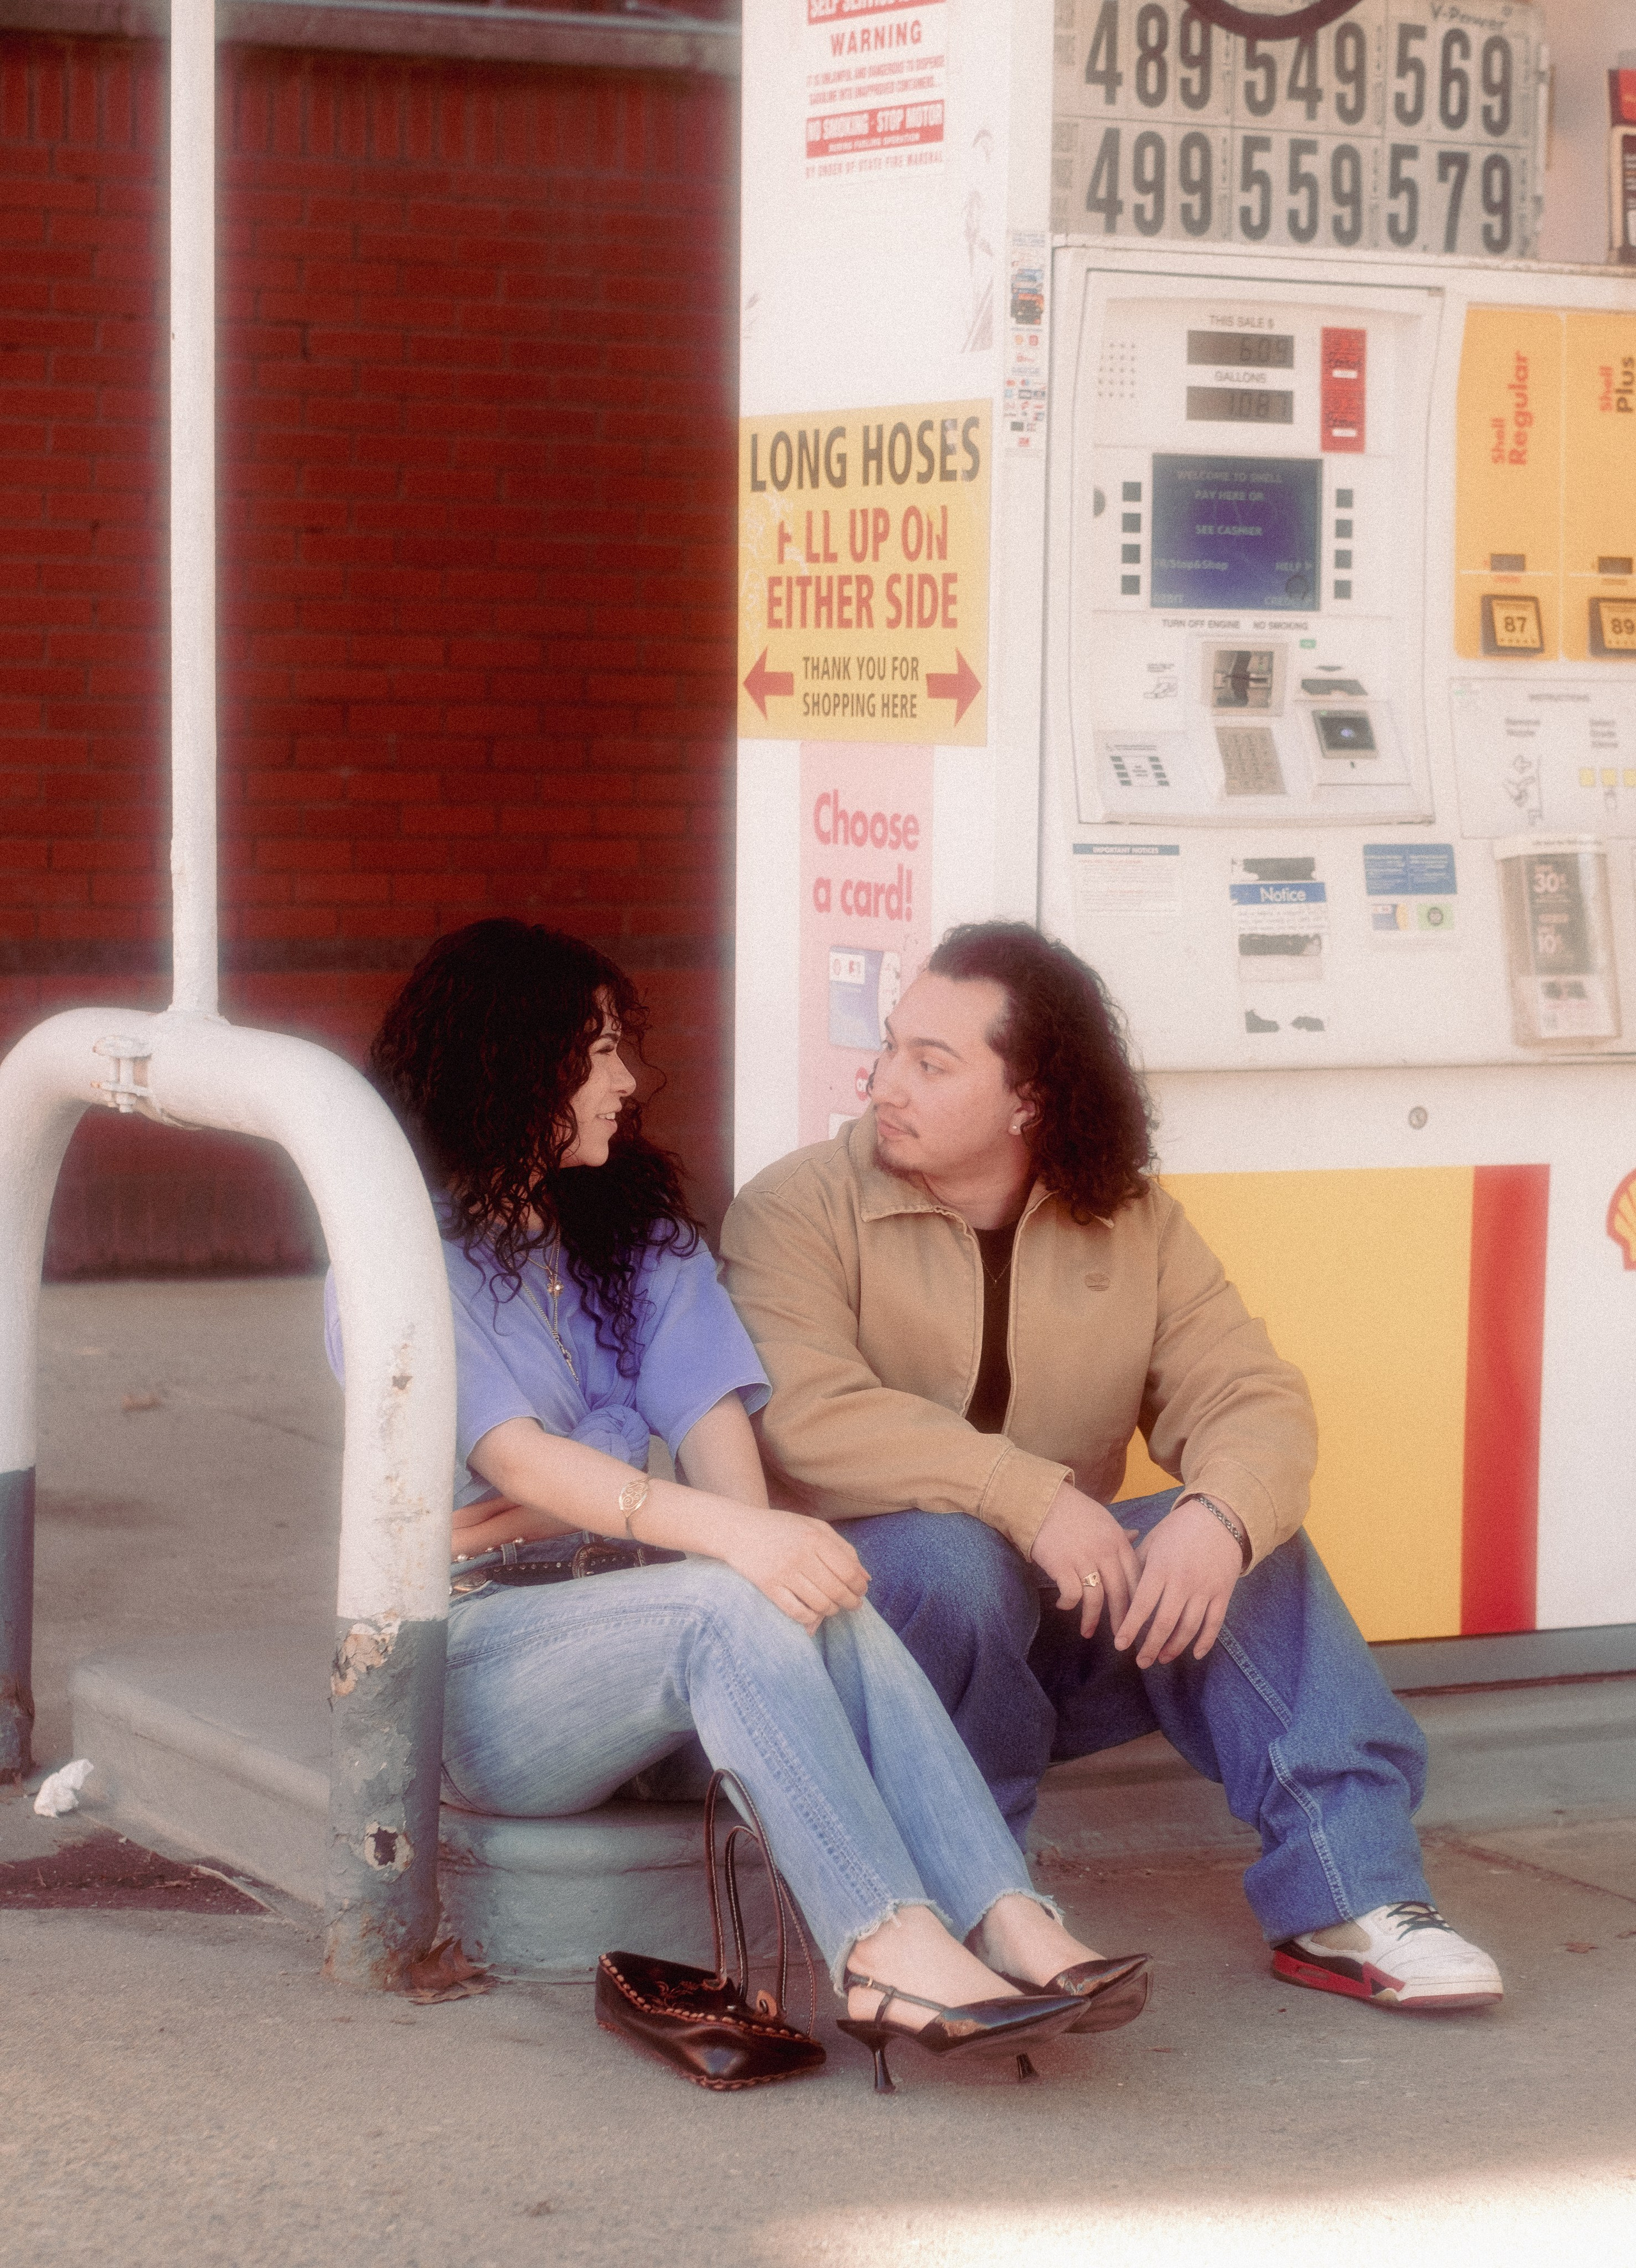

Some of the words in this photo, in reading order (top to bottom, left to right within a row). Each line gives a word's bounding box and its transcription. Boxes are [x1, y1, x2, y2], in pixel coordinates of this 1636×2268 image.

[830, 19, 922, 58] WARNING
[1244, 21, 1366, 125] 549
[1394, 23, 1513, 137] 569
[876, 108, 904, 133] STOP
[1084, 128, 1212, 237] 499
[1239, 135, 1362, 247] 559
[1388, 144, 1512, 254] 579
[1209, 315, 1234, 327] THIS
[1237, 316, 1265, 329] SALE
[1215, 371, 1267, 384] GALLONS
[1600, 366, 1614, 412] Shell
[1616, 356, 1635, 413] Plus
[1508, 350, 1534, 465] Regular
[750, 426, 847, 493] LONG
[861, 416, 981, 487] HOSES
[1491, 417, 1506, 465] Shell
[1177, 470, 1229, 481] WELCOME
[1194, 490, 1216, 500] PAY
[1219, 491, 1246, 501] HERE
[1249, 492, 1265, 501] OR
[777, 509, 838, 564] FLL
[849, 508, 890, 563] UP
[901, 504, 948, 562] ON
[1195, 525, 1214, 535] SEE
[1217, 525, 1263, 536] CASHIER
[767, 574, 874, 630] EITHER
[885, 573, 958, 630] SIDE
[1162, 619, 1186, 628] TURN
[1187, 620, 1205, 628] OFF
[1207, 620, 1240, 630] ENGINE
[1253, 621, 1266, 630] NO
[1269, 621, 1309, 630] SMOKING
[1504, 616, 1527, 633] 87
[1610, 617, 1635, 635] 89
[803, 656, 851, 680] THANK
[856, 656, 886, 681] YOU
[891, 657, 919, 681] FOR
[803, 693, 876, 717] SHOPPING
[881, 694, 918, 718] HERE
[813, 789, 920, 851] Choose
[813, 876, 831, 913] a
[840, 863, 913, 922] card!
[1260, 887, 1307, 902] Notice
